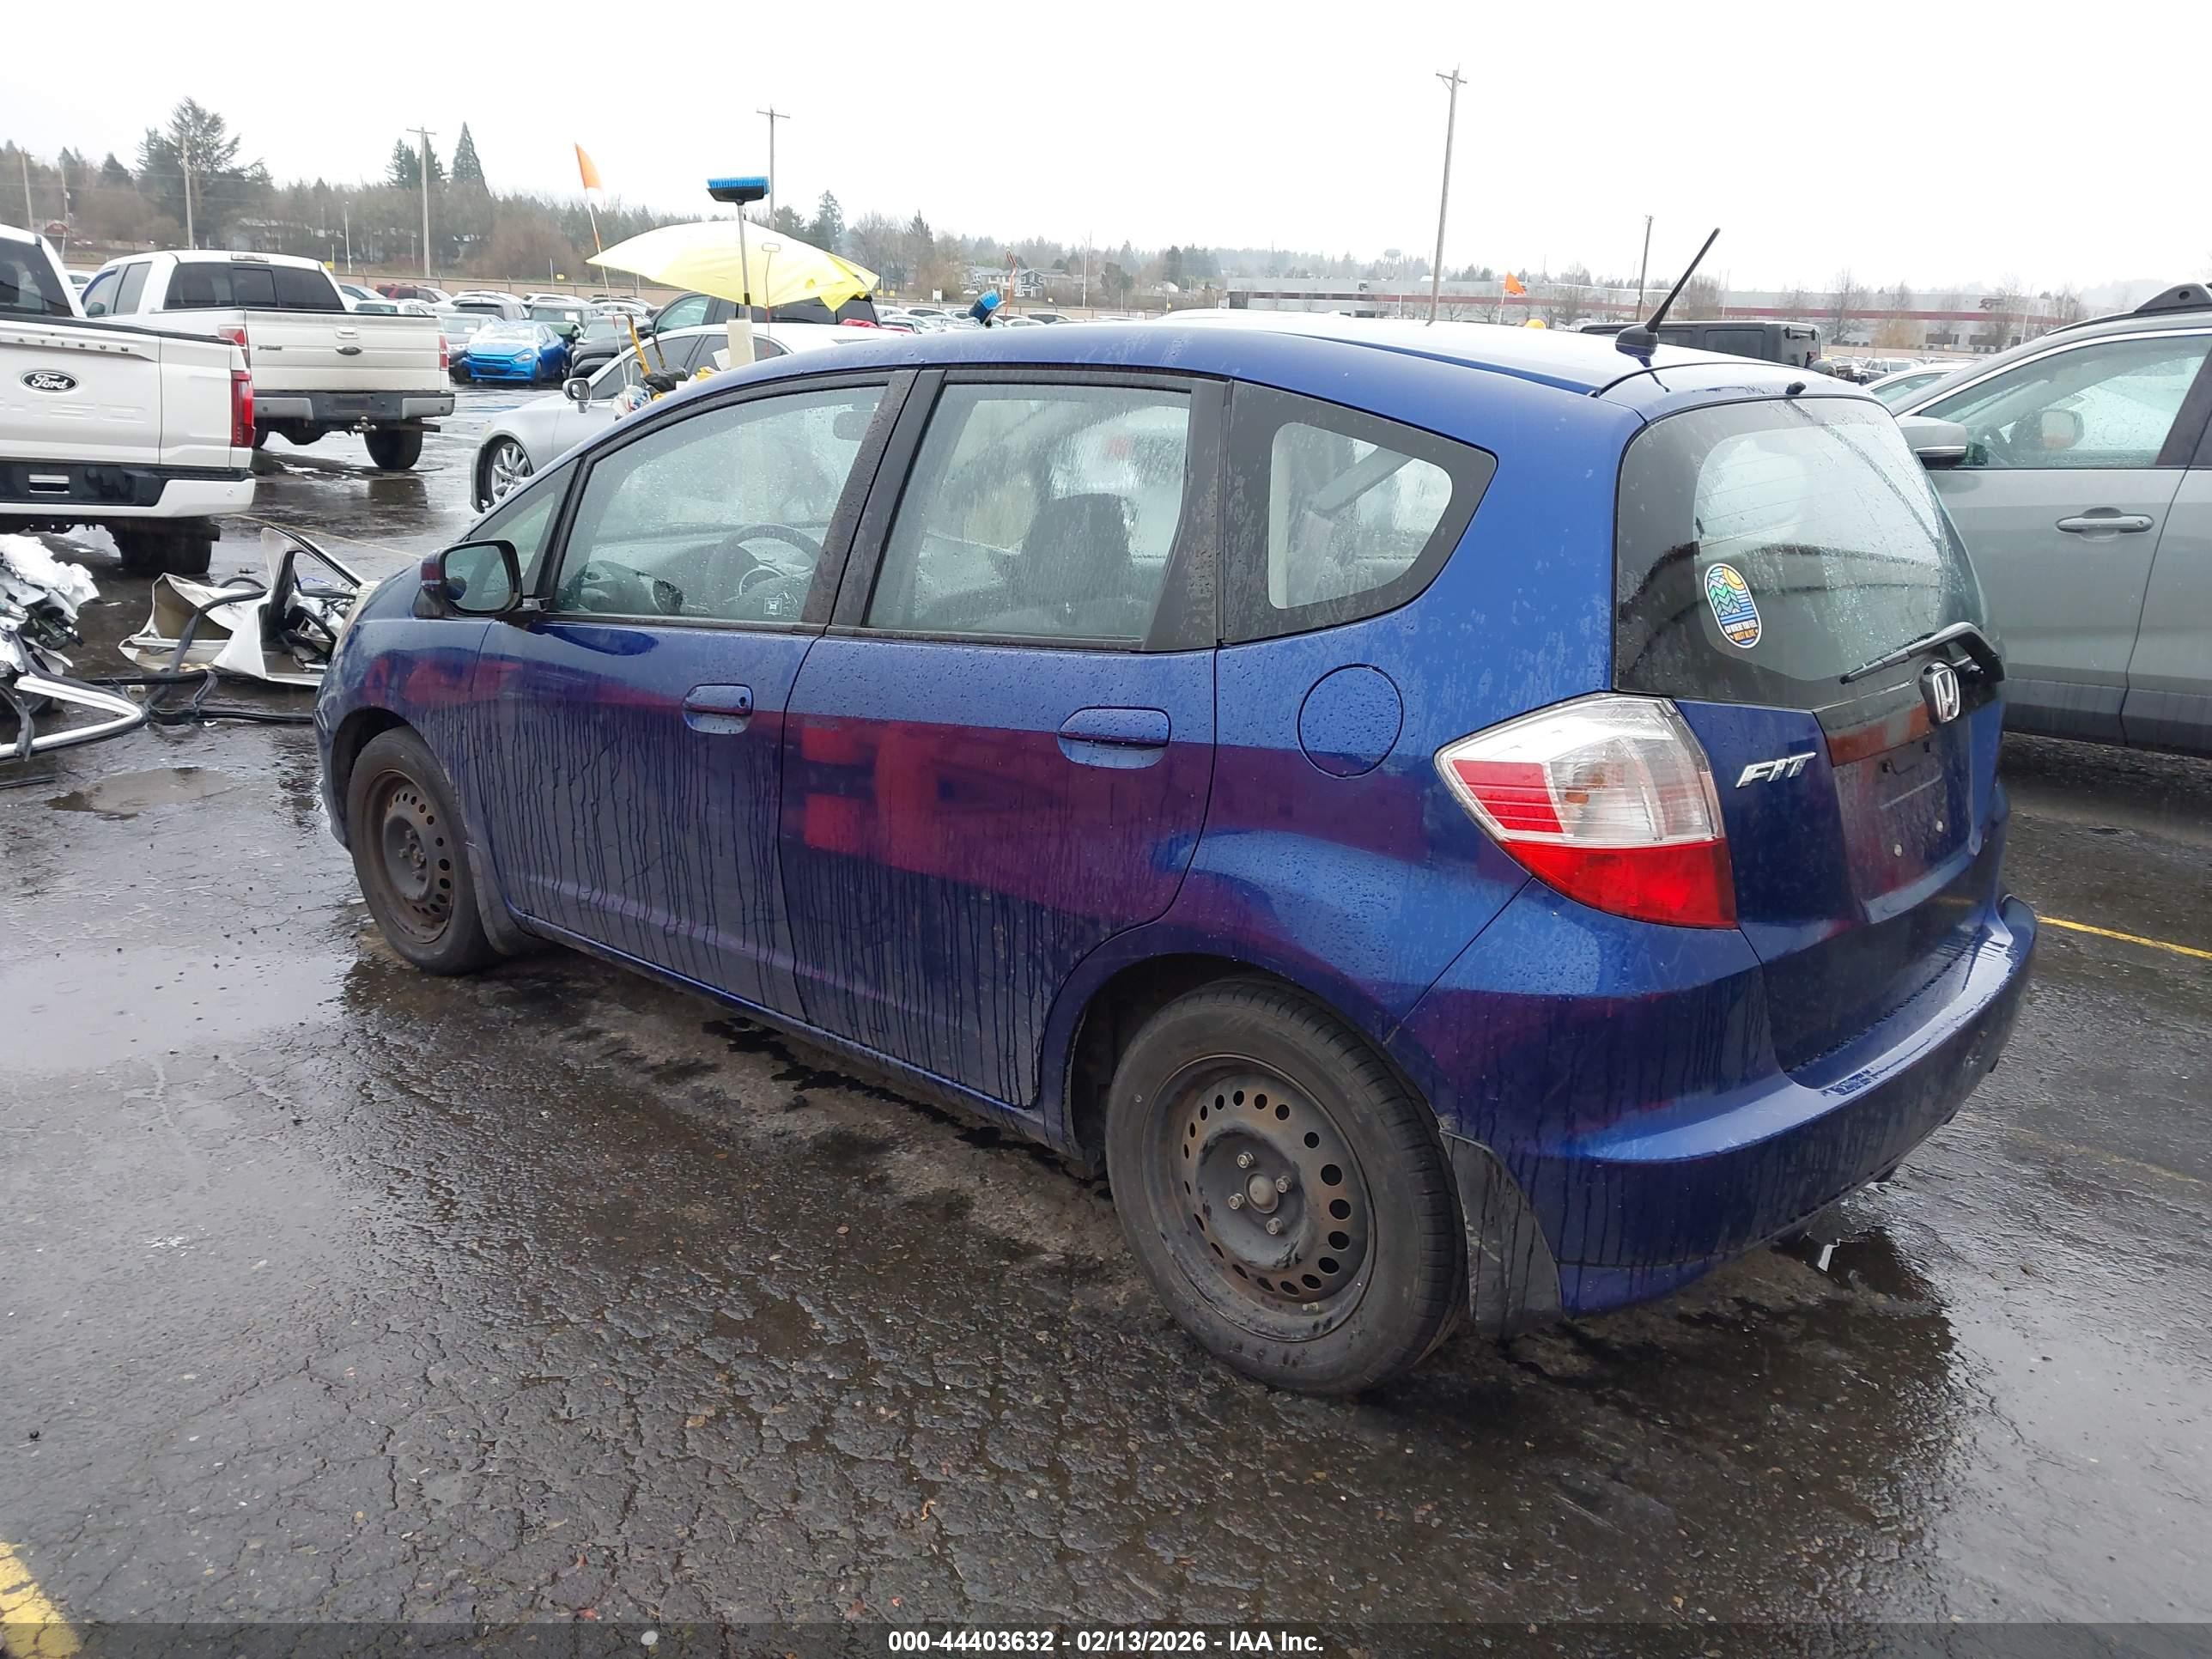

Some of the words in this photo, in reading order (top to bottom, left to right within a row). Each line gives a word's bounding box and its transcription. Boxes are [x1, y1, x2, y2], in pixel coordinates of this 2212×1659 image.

[0, 337, 129, 352] ATINUM
[31, 373, 69, 389] Ford
[1735, 752, 1817, 788] FIT
